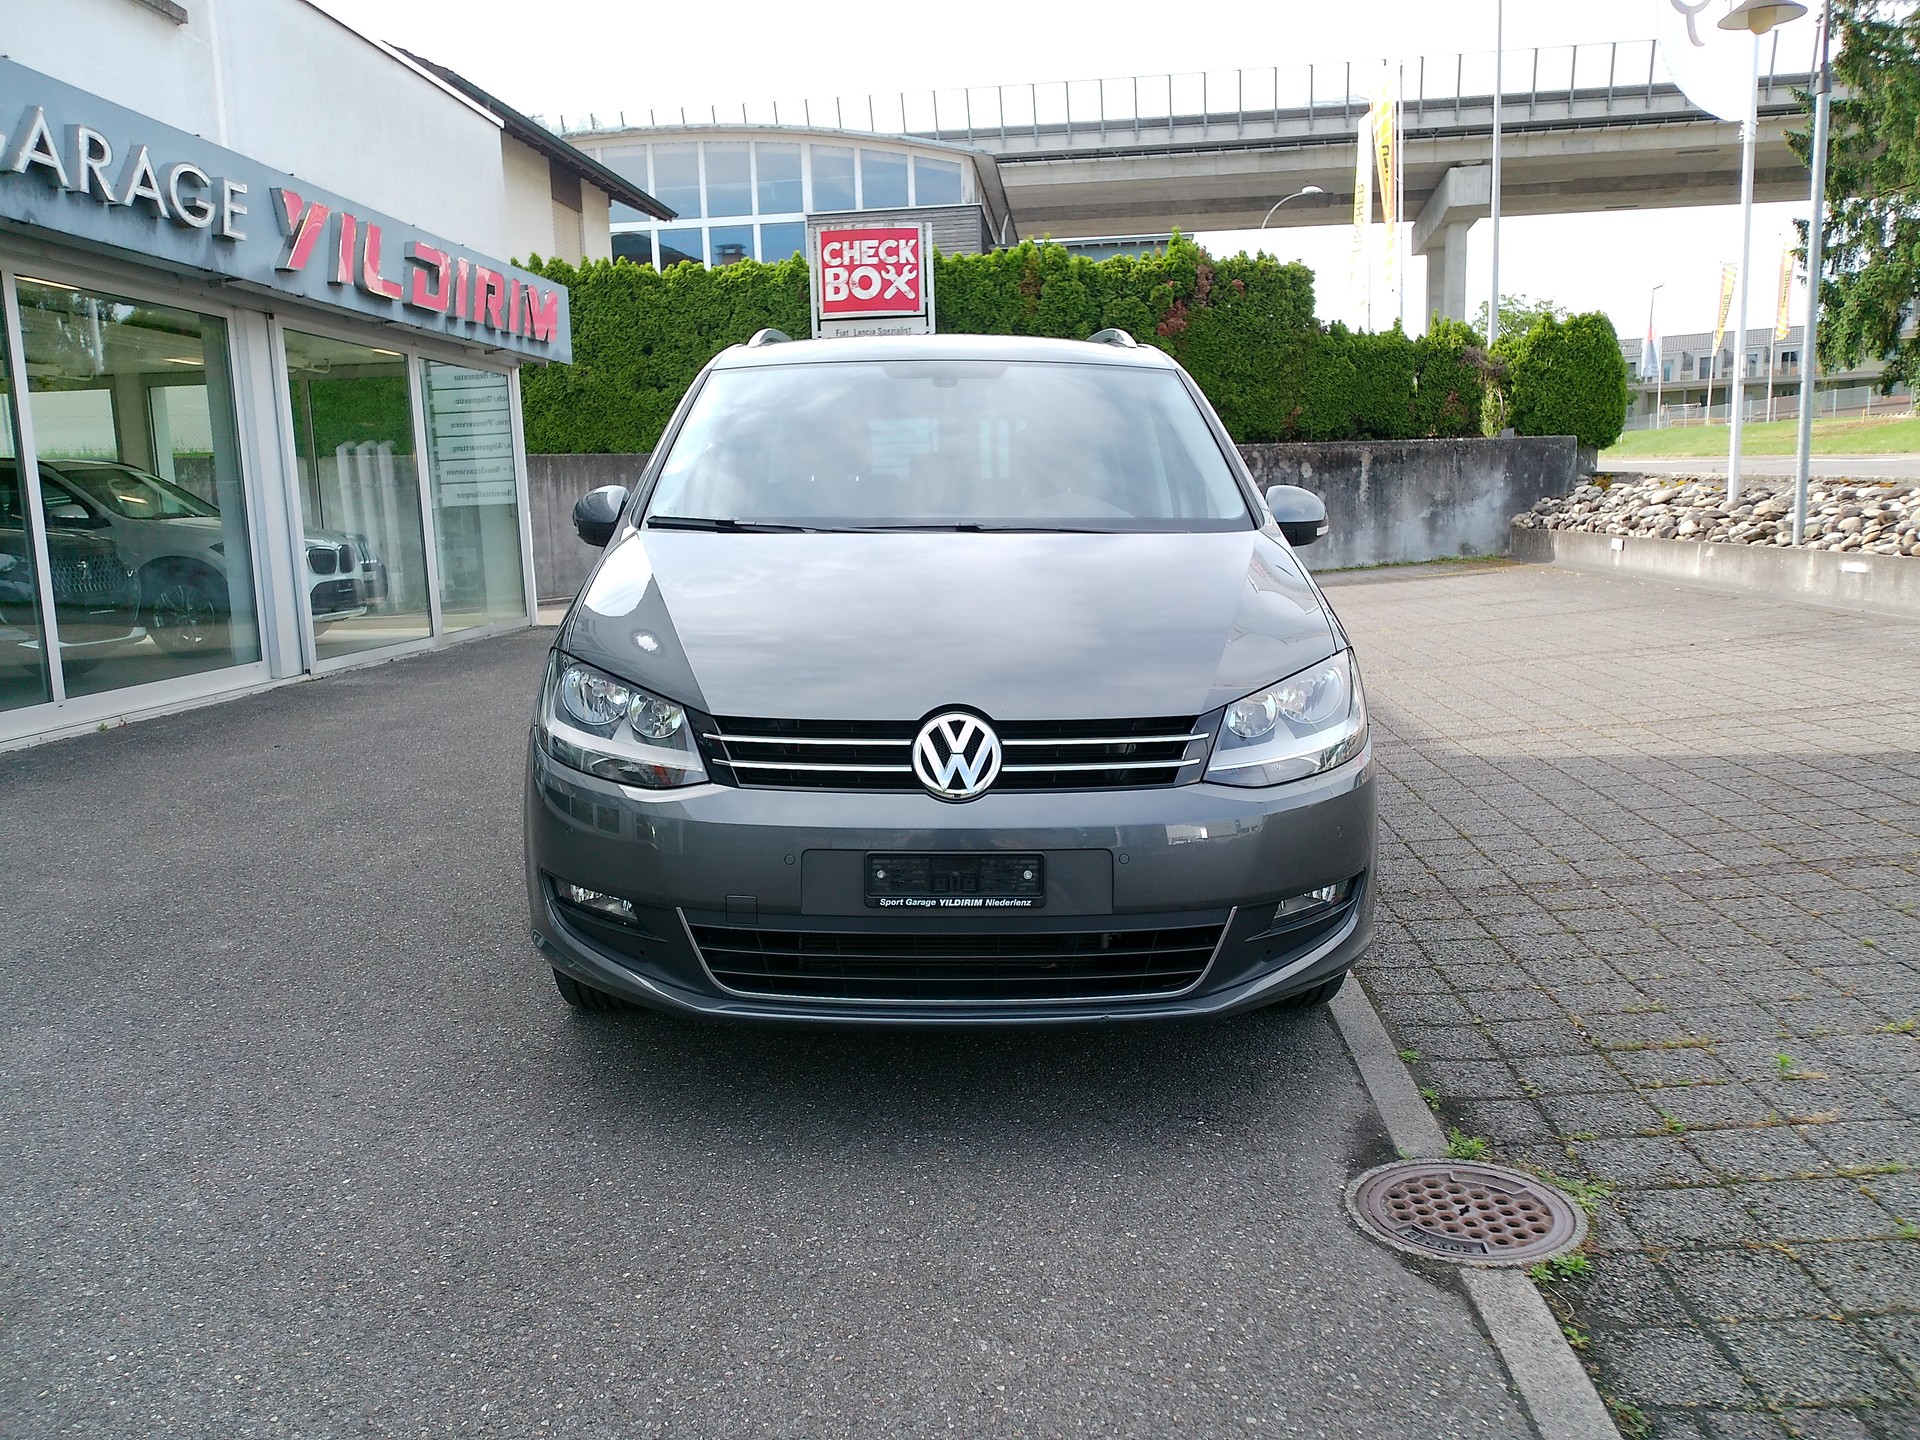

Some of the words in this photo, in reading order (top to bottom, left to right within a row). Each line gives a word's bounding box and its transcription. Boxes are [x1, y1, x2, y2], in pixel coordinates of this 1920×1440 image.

[0, 105, 248, 241] ARAGE
[270, 188, 558, 343] YILDIRIM
[823, 239, 917, 266] CHECK
[824, 265, 917, 301] BOX
[835, 329, 849, 337] Fiat
[853, 327, 876, 336] Lancia
[879, 898, 904, 908] Sport
[905, 898, 937, 908] Garage
[939, 898, 983, 907] YILDIRIM
[985, 898, 1032, 907] Niederlenz
